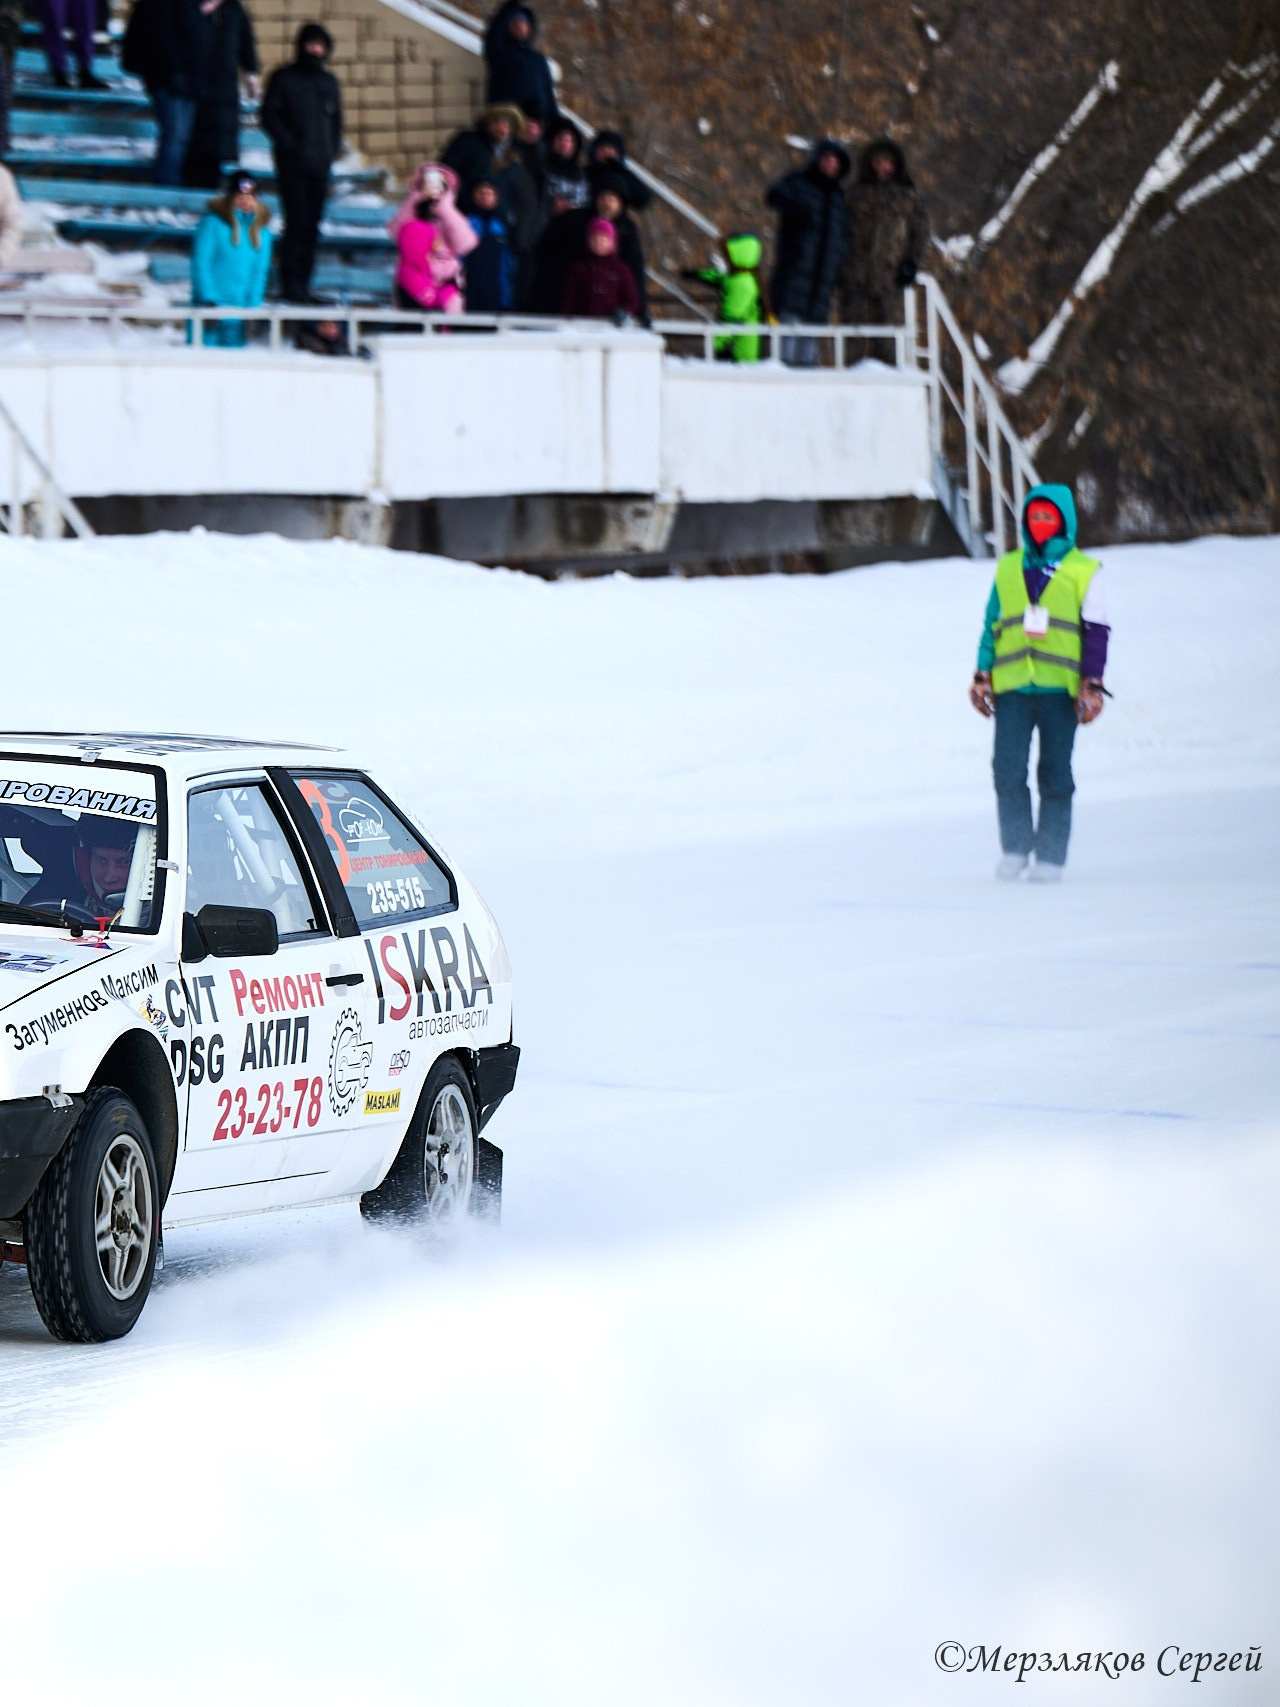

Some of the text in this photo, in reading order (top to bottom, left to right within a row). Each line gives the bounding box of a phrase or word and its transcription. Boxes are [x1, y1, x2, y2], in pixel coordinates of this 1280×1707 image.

[298, 778, 351, 884] 3
[350, 849, 429, 874] ЦЕНТР ТОНИРОВАНИЯ
[367, 876, 426, 914] 235-515
[165, 968, 325, 1028] CVT Ремонт
[364, 923, 493, 1024] ISKRA
[5, 989, 108, 1051] Загуменнов
[100, 963, 159, 1001] Максим
[408, 1009, 489, 1040] автозапчасти
[171, 1016, 309, 1088] DSG АКПП
[213, 1076, 323, 1141] 23-23-78
[365, 1091, 401, 1111] MASLAMI
